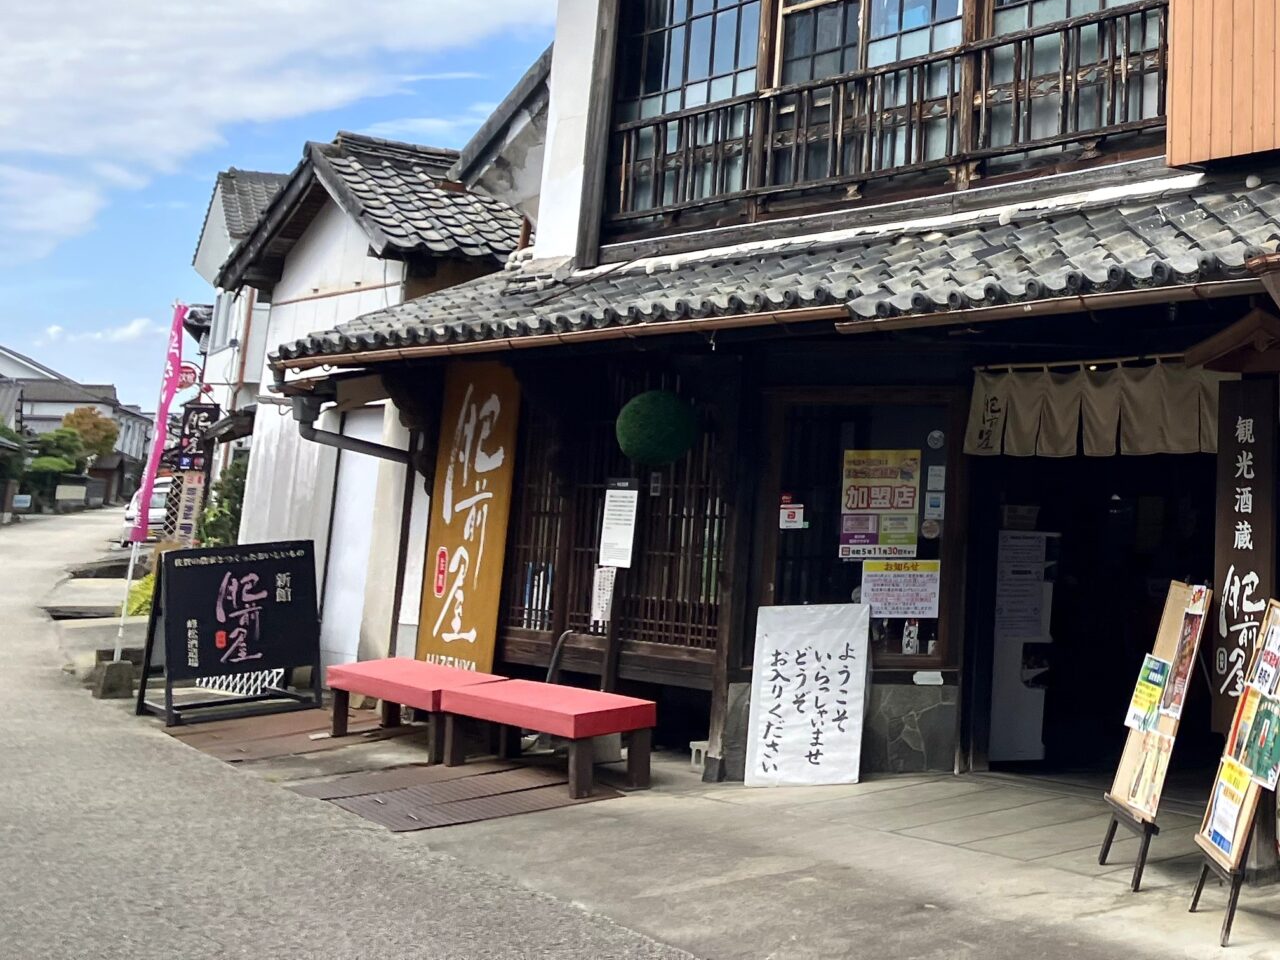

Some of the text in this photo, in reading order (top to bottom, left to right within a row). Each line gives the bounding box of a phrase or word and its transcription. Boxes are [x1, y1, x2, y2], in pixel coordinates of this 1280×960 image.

[432, 383, 504, 643] 肥前屋
[846, 485, 917, 510] 加盟店
[1233, 415, 1255, 550] 観光酒蔵
[275, 572, 292, 602] 新館
[883, 561, 920, 572] お知らせ
[215, 571, 268, 663] 肥前屋
[761, 649, 791, 773] お入りください
[792, 646, 812, 714] どうぞ
[804, 650, 832, 766] いらっしゃいませ
[832, 642, 856, 732] ようこそ
